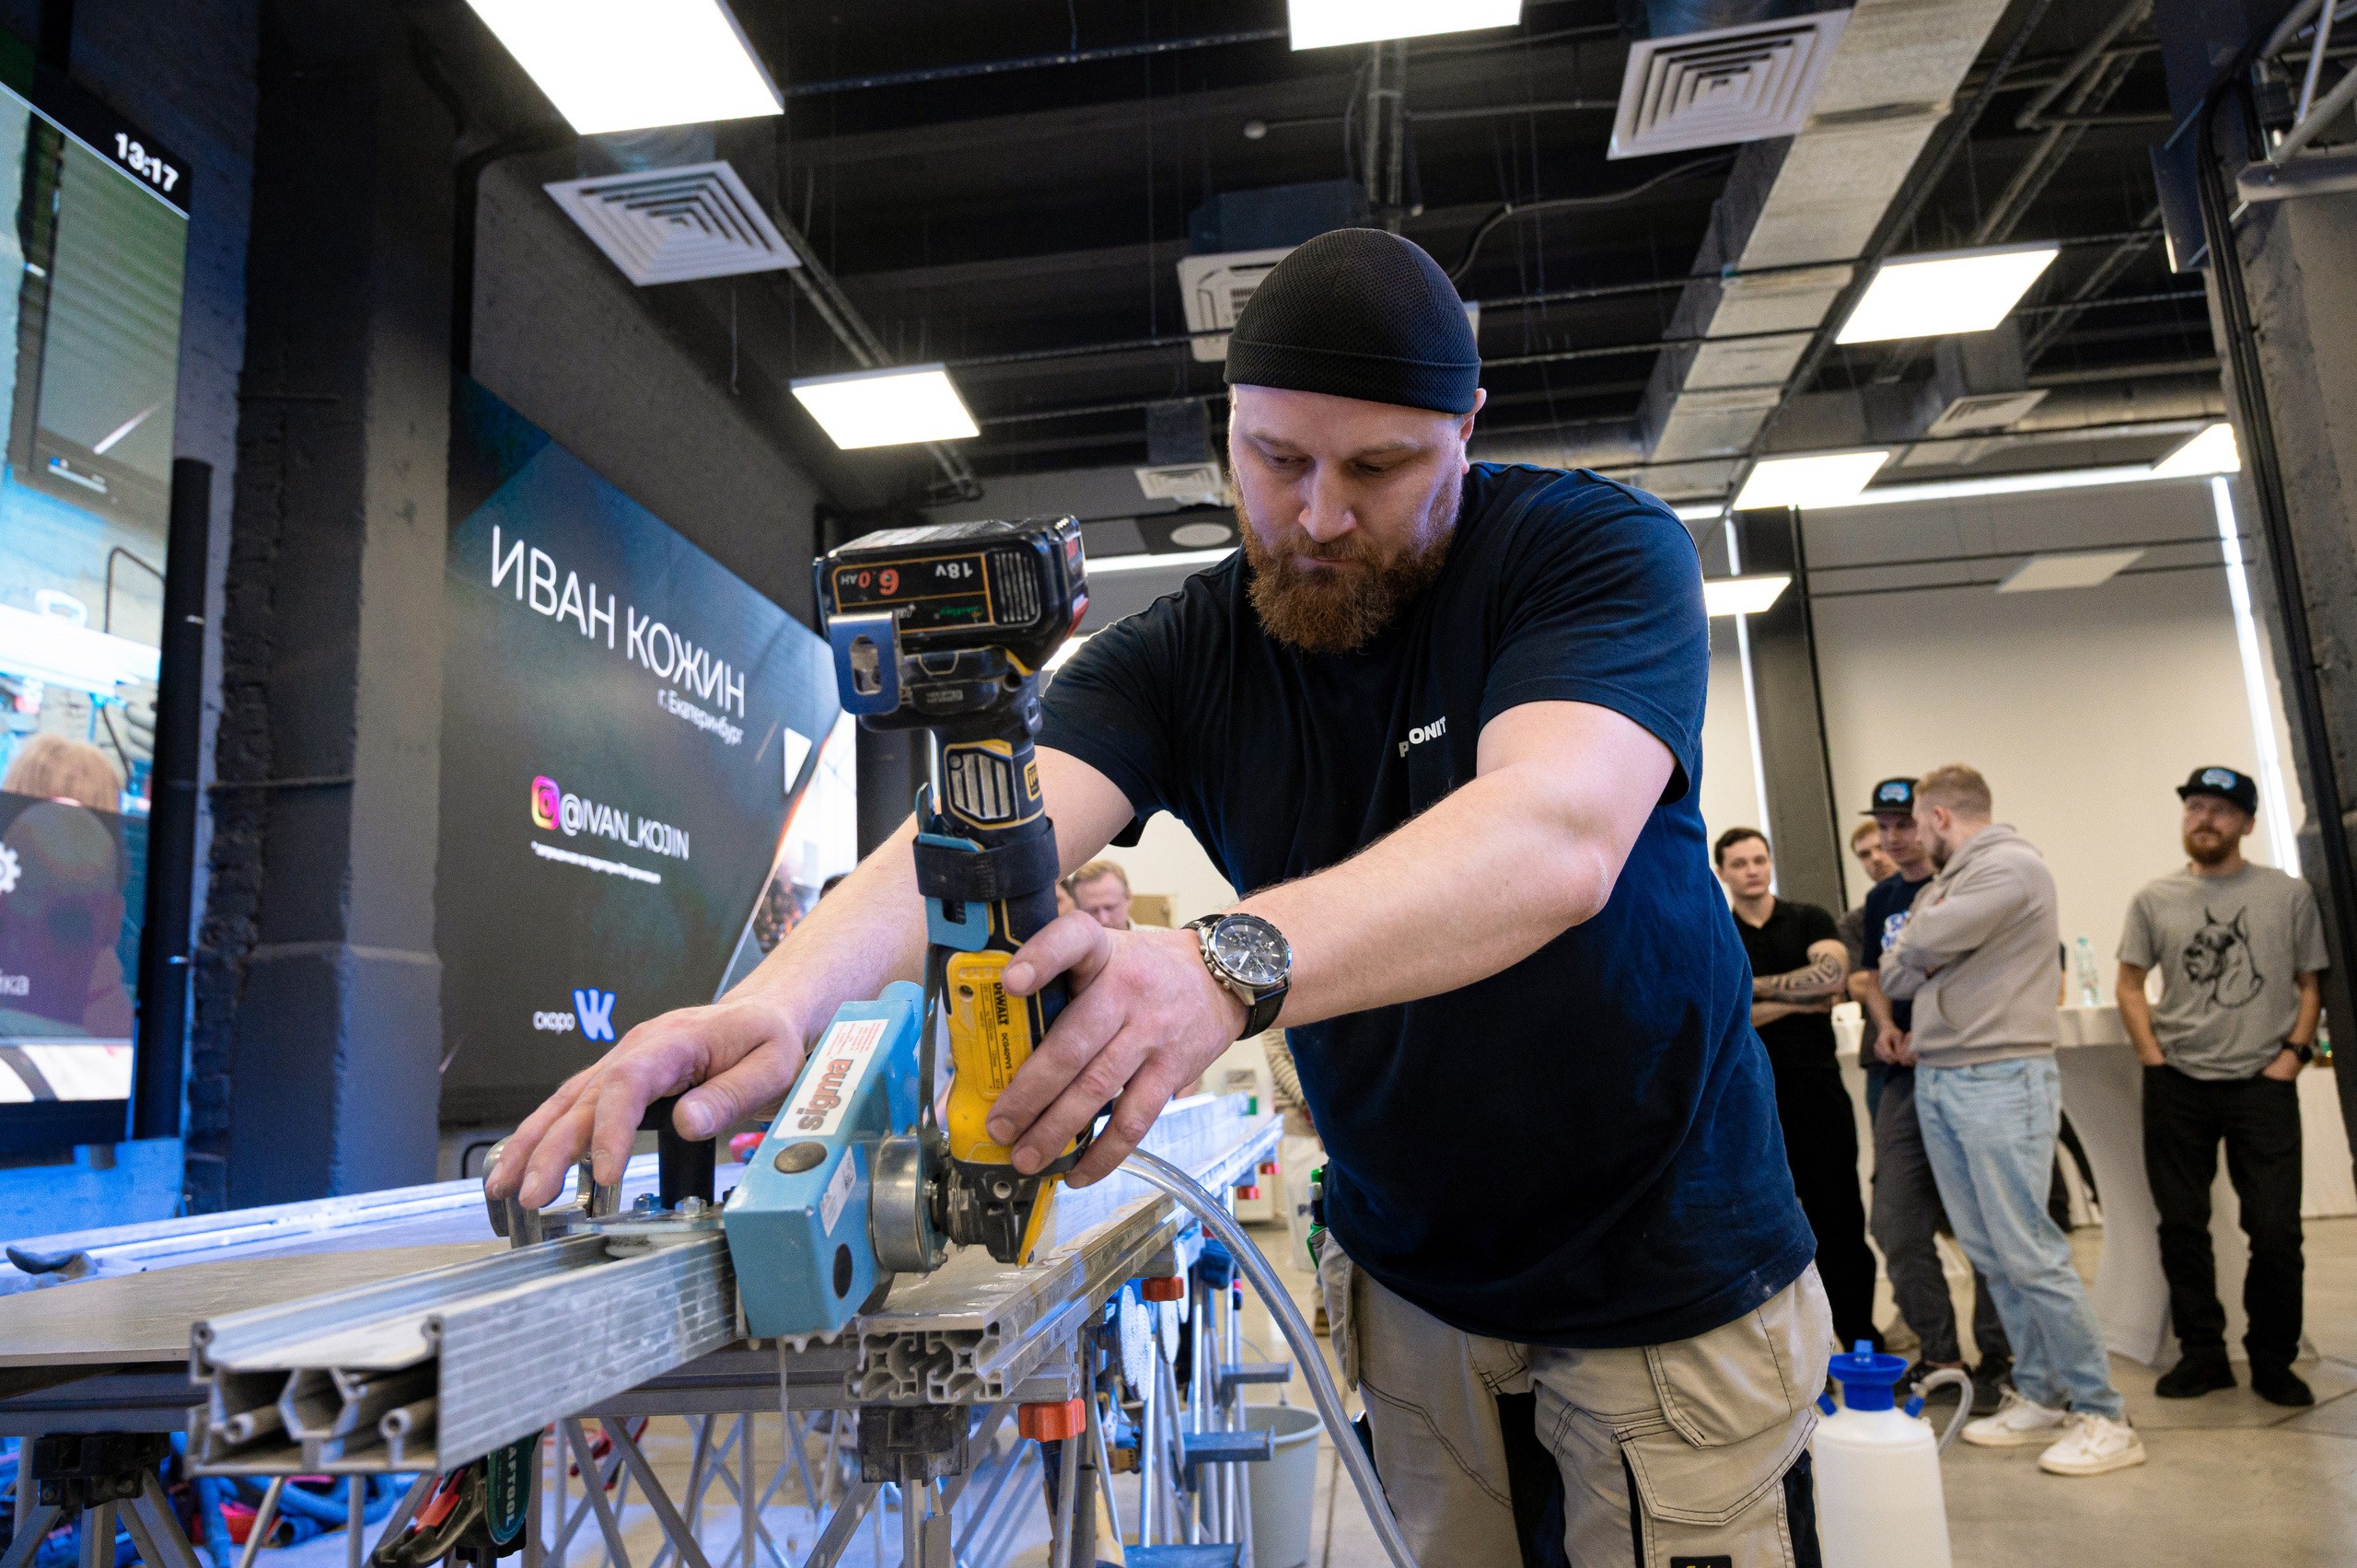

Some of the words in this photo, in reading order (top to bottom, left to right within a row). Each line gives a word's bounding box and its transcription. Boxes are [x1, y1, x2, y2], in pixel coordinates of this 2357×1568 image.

[114, 131, 180, 192] 13:17
[490, 524, 616, 650] ИВАН
[626, 604, 746, 719] КОЖИН
[1398, 715, 1446, 758] PONIT
[560, 792, 691, 861] @IVAN_KOJIN
[0, 969, 29, 996] ка
[532, 1010, 575, 1035] скоро
[796, 1058, 854, 1132] sigma
[505, 1446, 517, 1527] AFTOOL
